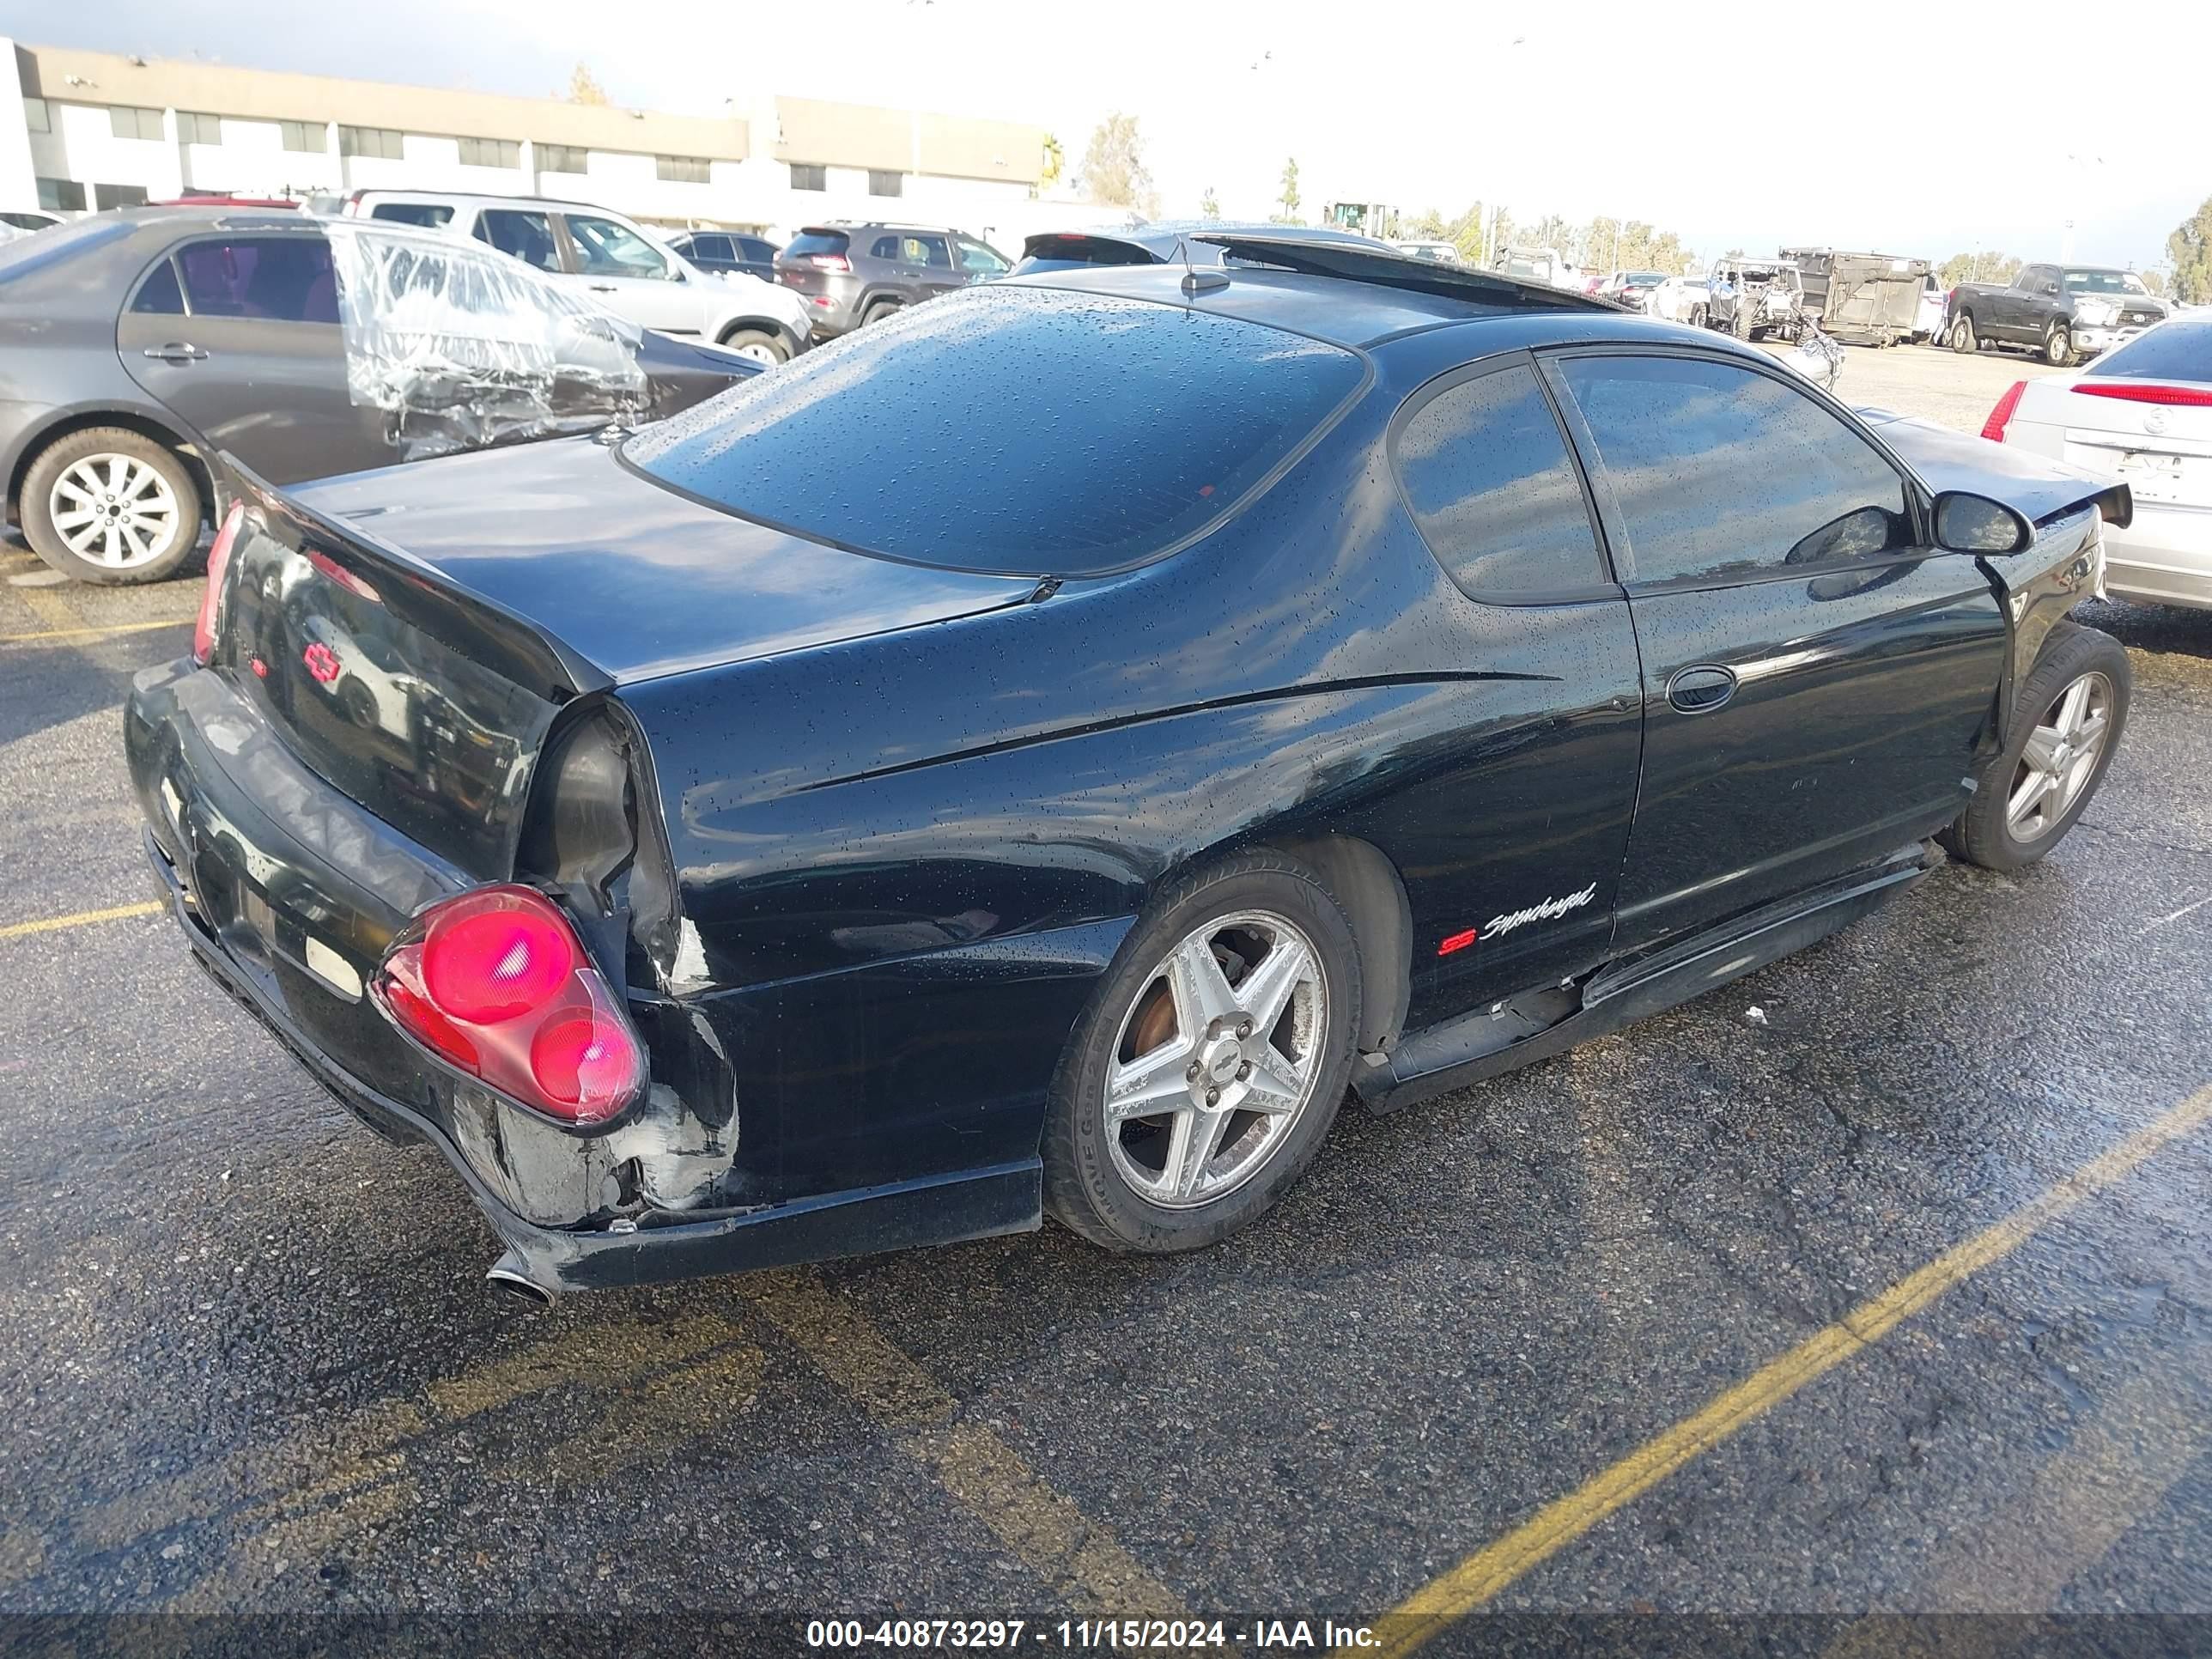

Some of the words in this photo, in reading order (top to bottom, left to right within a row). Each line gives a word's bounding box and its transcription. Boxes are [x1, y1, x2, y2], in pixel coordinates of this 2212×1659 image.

[1437, 927, 1477, 956] SS
[1479, 882, 1596, 940] Supercharged
[1087, 1061, 1097, 1078] 2
[1082, 1085, 1096, 1135] Gen
